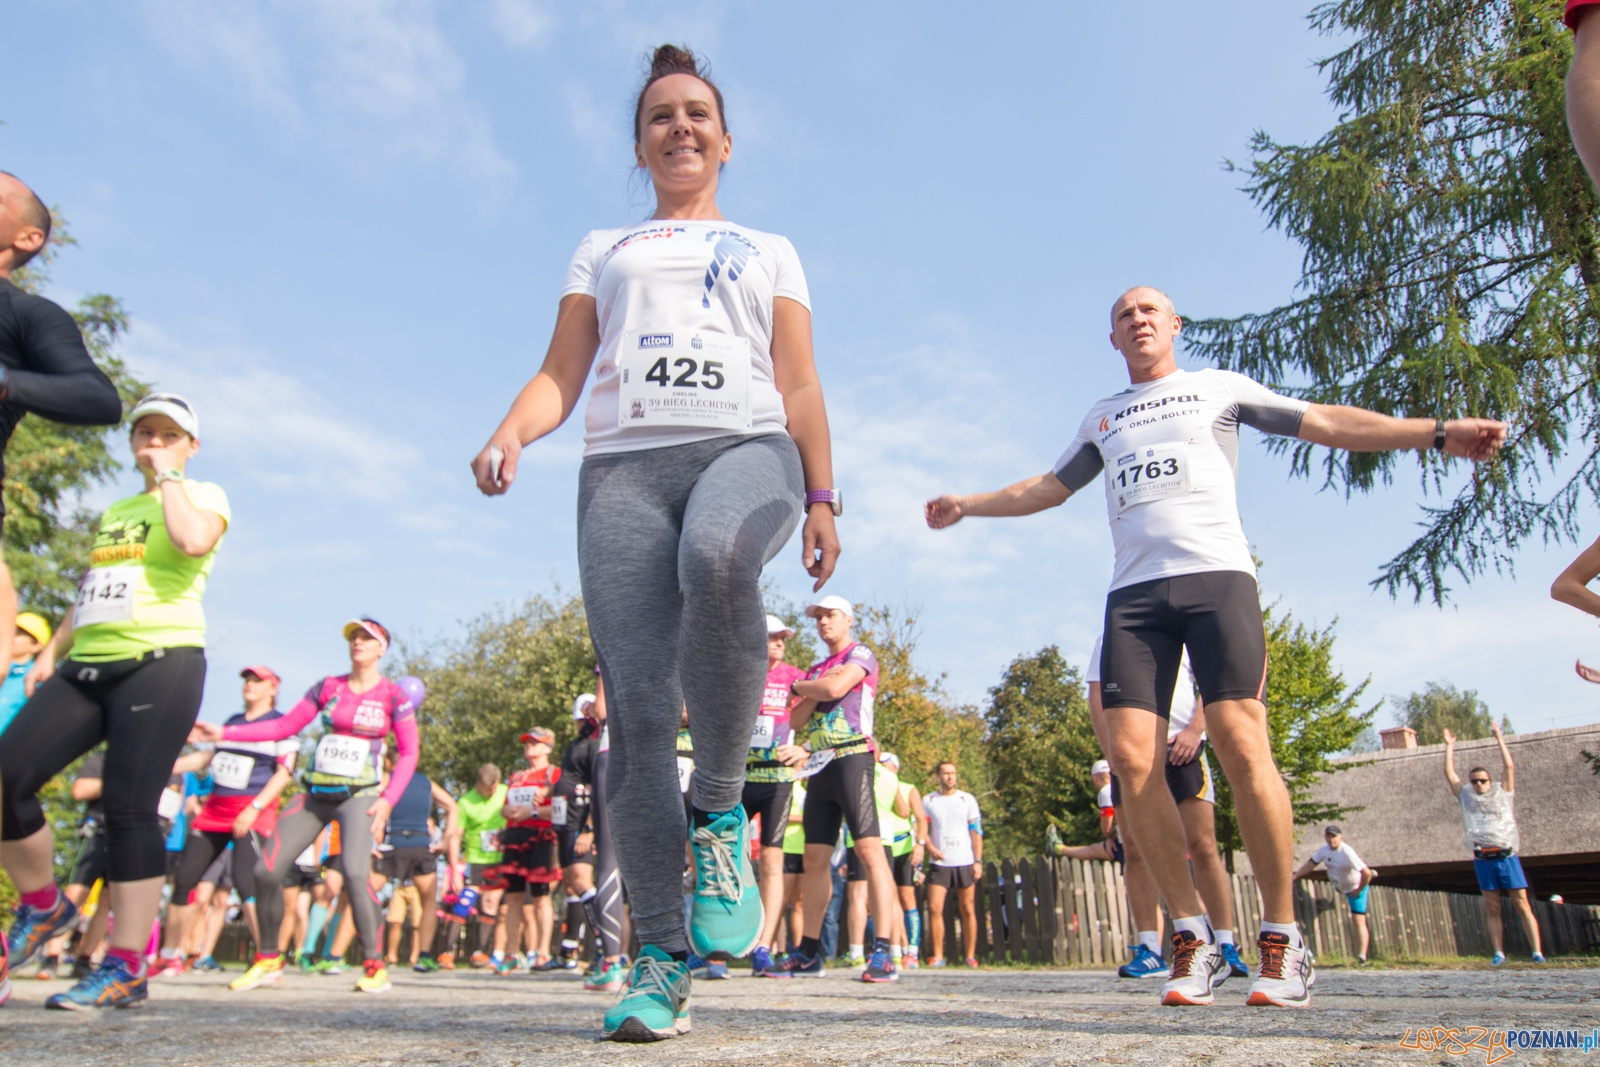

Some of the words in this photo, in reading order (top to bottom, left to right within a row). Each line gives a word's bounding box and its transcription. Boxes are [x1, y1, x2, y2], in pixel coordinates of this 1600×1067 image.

[645, 357, 725, 390] 425
[648, 398, 660, 407] 39
[663, 398, 687, 407] BIEG
[690, 399, 739, 411] LECHITÓW
[1115, 394, 1207, 421] KRISPOL
[1129, 417, 1157, 429] OKNA
[1161, 409, 1200, 420] ROLETY
[1117, 458, 1179, 488] 1763
[1133, 485, 1147, 494] BIEG
[90, 544, 145, 563] NISHER
[323, 747, 359, 761] 1965
